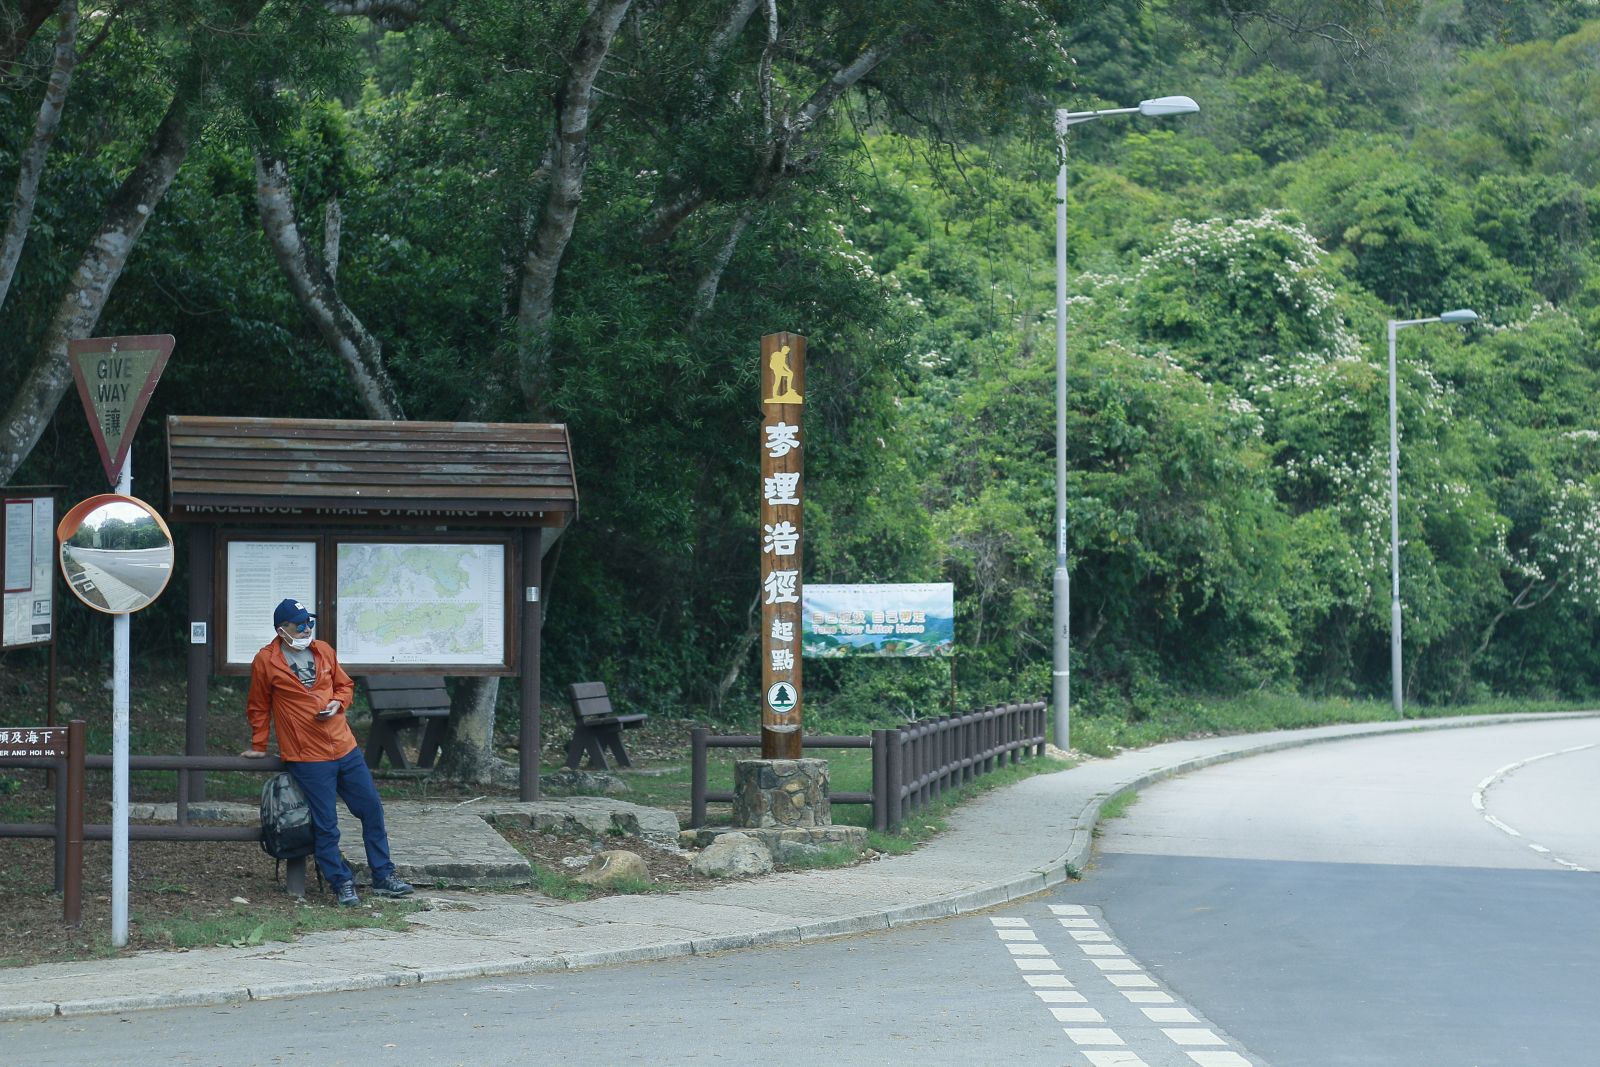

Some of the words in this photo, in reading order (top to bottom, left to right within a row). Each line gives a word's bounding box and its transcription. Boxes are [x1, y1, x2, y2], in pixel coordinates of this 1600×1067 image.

[97, 358, 132, 379] GIVE
[97, 383, 130, 402] WAY
[105, 408, 121, 437] 讓
[812, 624, 837, 634] Take
[839, 624, 864, 634] Your
[865, 624, 895, 634] Litter
[895, 624, 925, 634] Home
